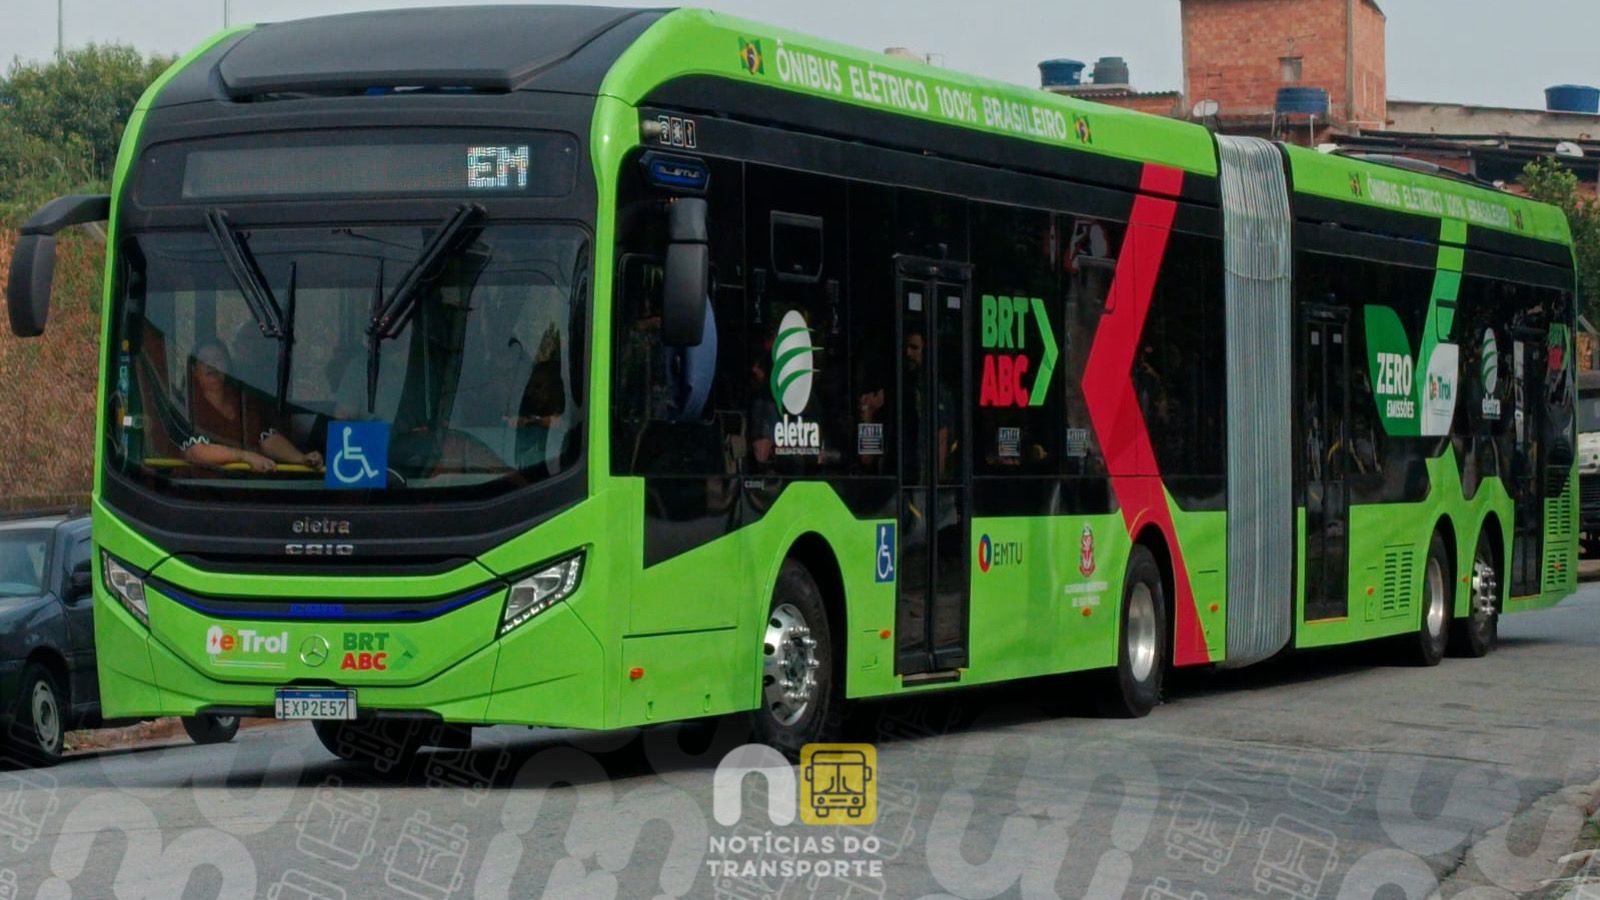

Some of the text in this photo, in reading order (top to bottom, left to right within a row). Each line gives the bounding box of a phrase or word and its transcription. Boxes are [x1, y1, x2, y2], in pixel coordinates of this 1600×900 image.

[775, 38, 1067, 140] ÔNIBUS ELÉTRICO 100% BRASILEIRO
[467, 145, 529, 188] EM
[981, 294, 1029, 349] BRT
[979, 354, 1029, 408] ABC
[1376, 352, 1413, 396] ZERO
[774, 413, 820, 447] eletra
[292, 516, 350, 534] eletra
[993, 541, 1023, 566] EMTU
[343, 632, 389, 650] BRT
[340, 652, 387, 670] ABC
[283, 700, 346, 716] EXP2E57
